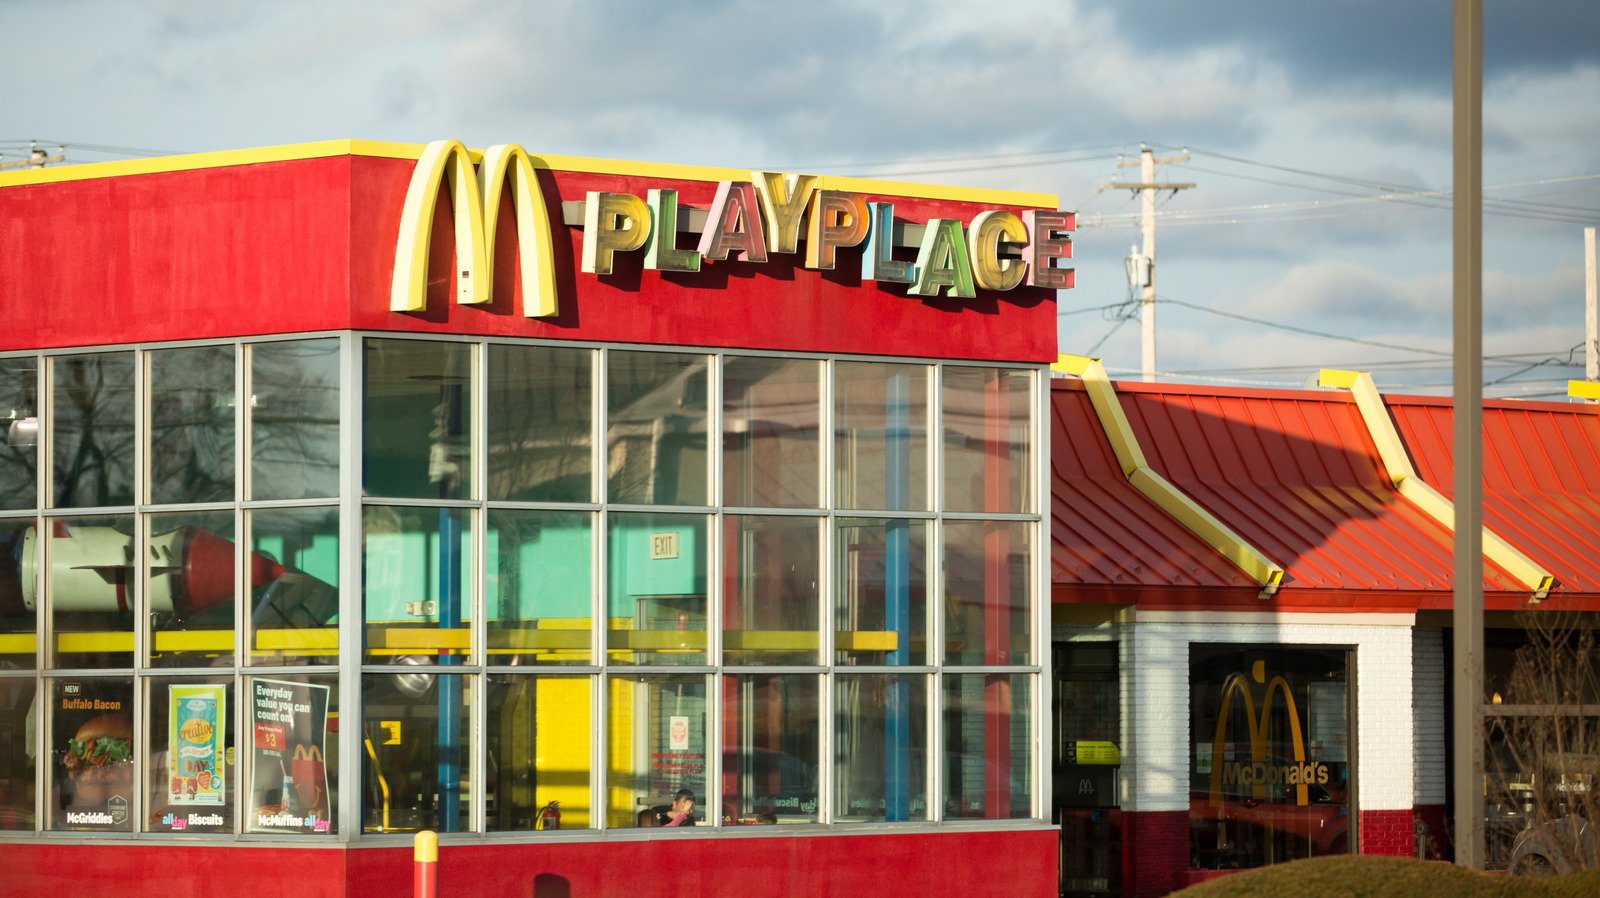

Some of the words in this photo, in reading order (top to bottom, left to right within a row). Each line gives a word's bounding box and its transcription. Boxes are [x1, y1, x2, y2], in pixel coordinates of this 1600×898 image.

[581, 171, 1077, 298] PLAYPLACE
[654, 536, 673, 556] EXIT
[64, 685, 80, 694] NEW
[256, 684, 293, 700] Everyday
[62, 698, 93, 710] Buffalo
[93, 698, 121, 710] Bacon
[257, 698, 278, 710] value
[278, 701, 294, 712] you
[294, 703, 311, 714] can
[257, 710, 280, 721] count
[265, 733, 277, 747] $3
[1223, 761, 1329, 785] McDonald's
[67, 812, 114, 824] McGriddles
[188, 813, 224, 825] Biscuits
[258, 815, 303, 827] McMuffins
